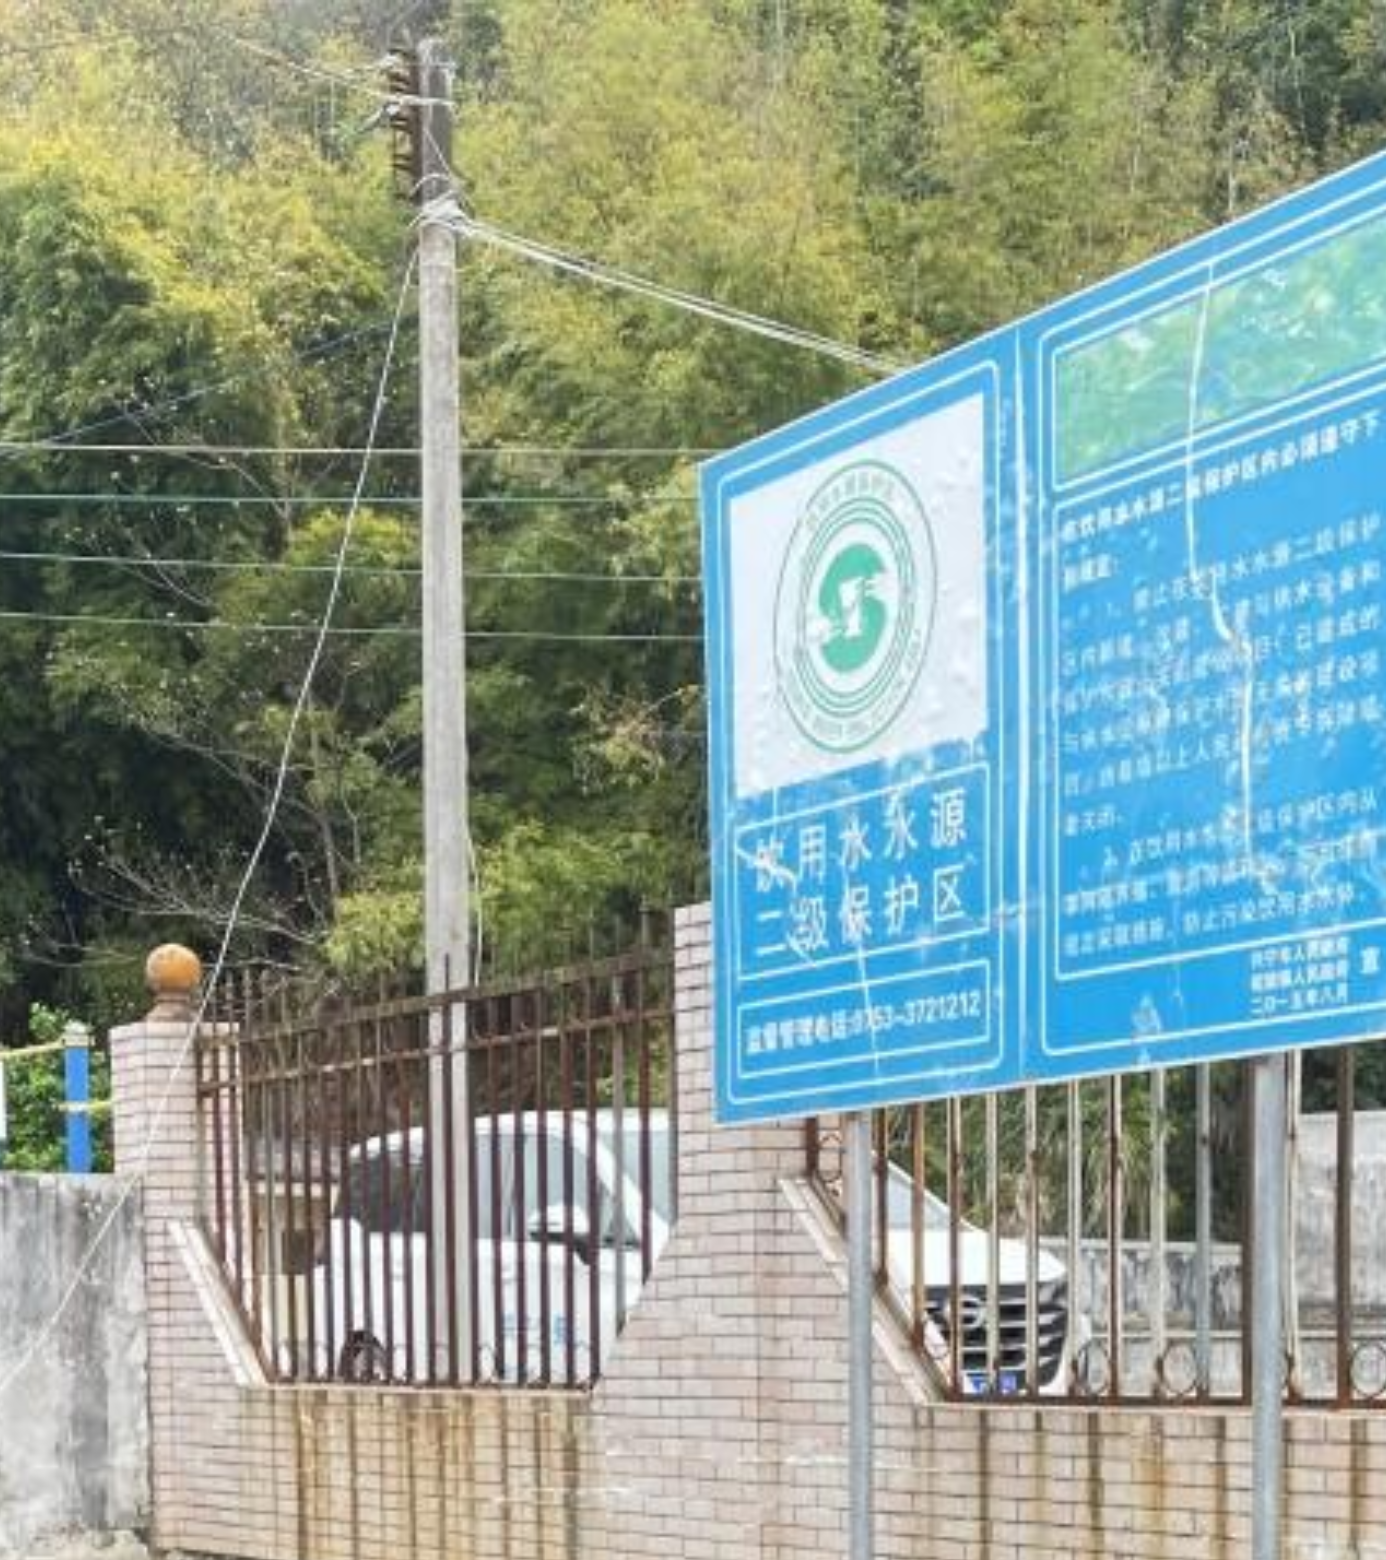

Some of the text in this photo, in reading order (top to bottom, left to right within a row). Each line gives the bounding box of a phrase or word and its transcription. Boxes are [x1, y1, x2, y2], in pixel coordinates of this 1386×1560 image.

[755, 787, 967, 893] 饮用水水源
[755, 864, 965, 955] 二级保护区
